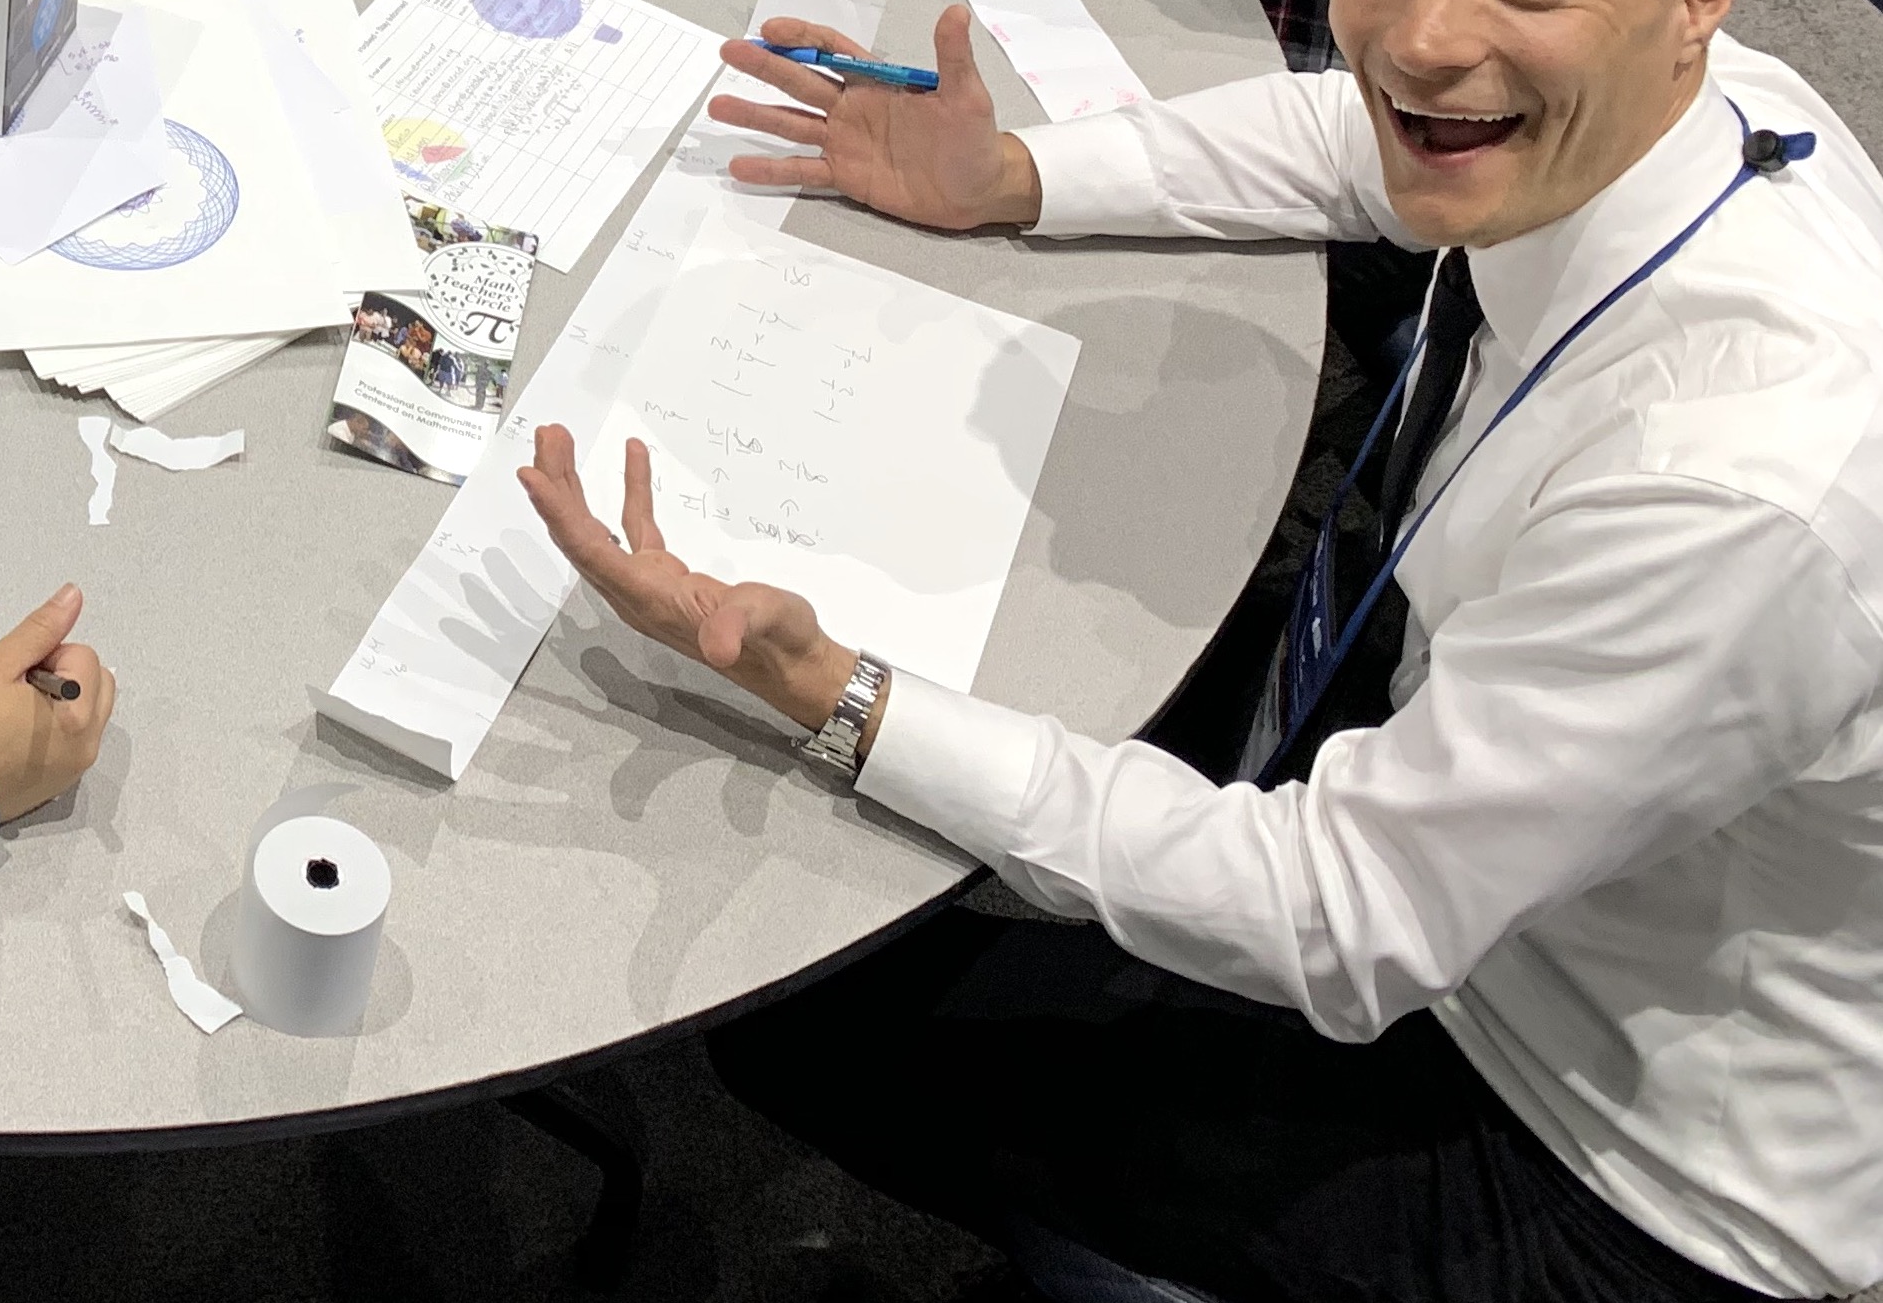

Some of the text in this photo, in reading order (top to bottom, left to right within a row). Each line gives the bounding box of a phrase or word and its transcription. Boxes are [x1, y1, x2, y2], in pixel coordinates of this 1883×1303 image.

[442, 274, 519, 302] Teachers'
[473, 274, 516, 294] Math
[465, 294, 512, 313] Circle
[358, 379, 415, 410] Professional
[354, 388, 482, 440] Centered on Mathematics
